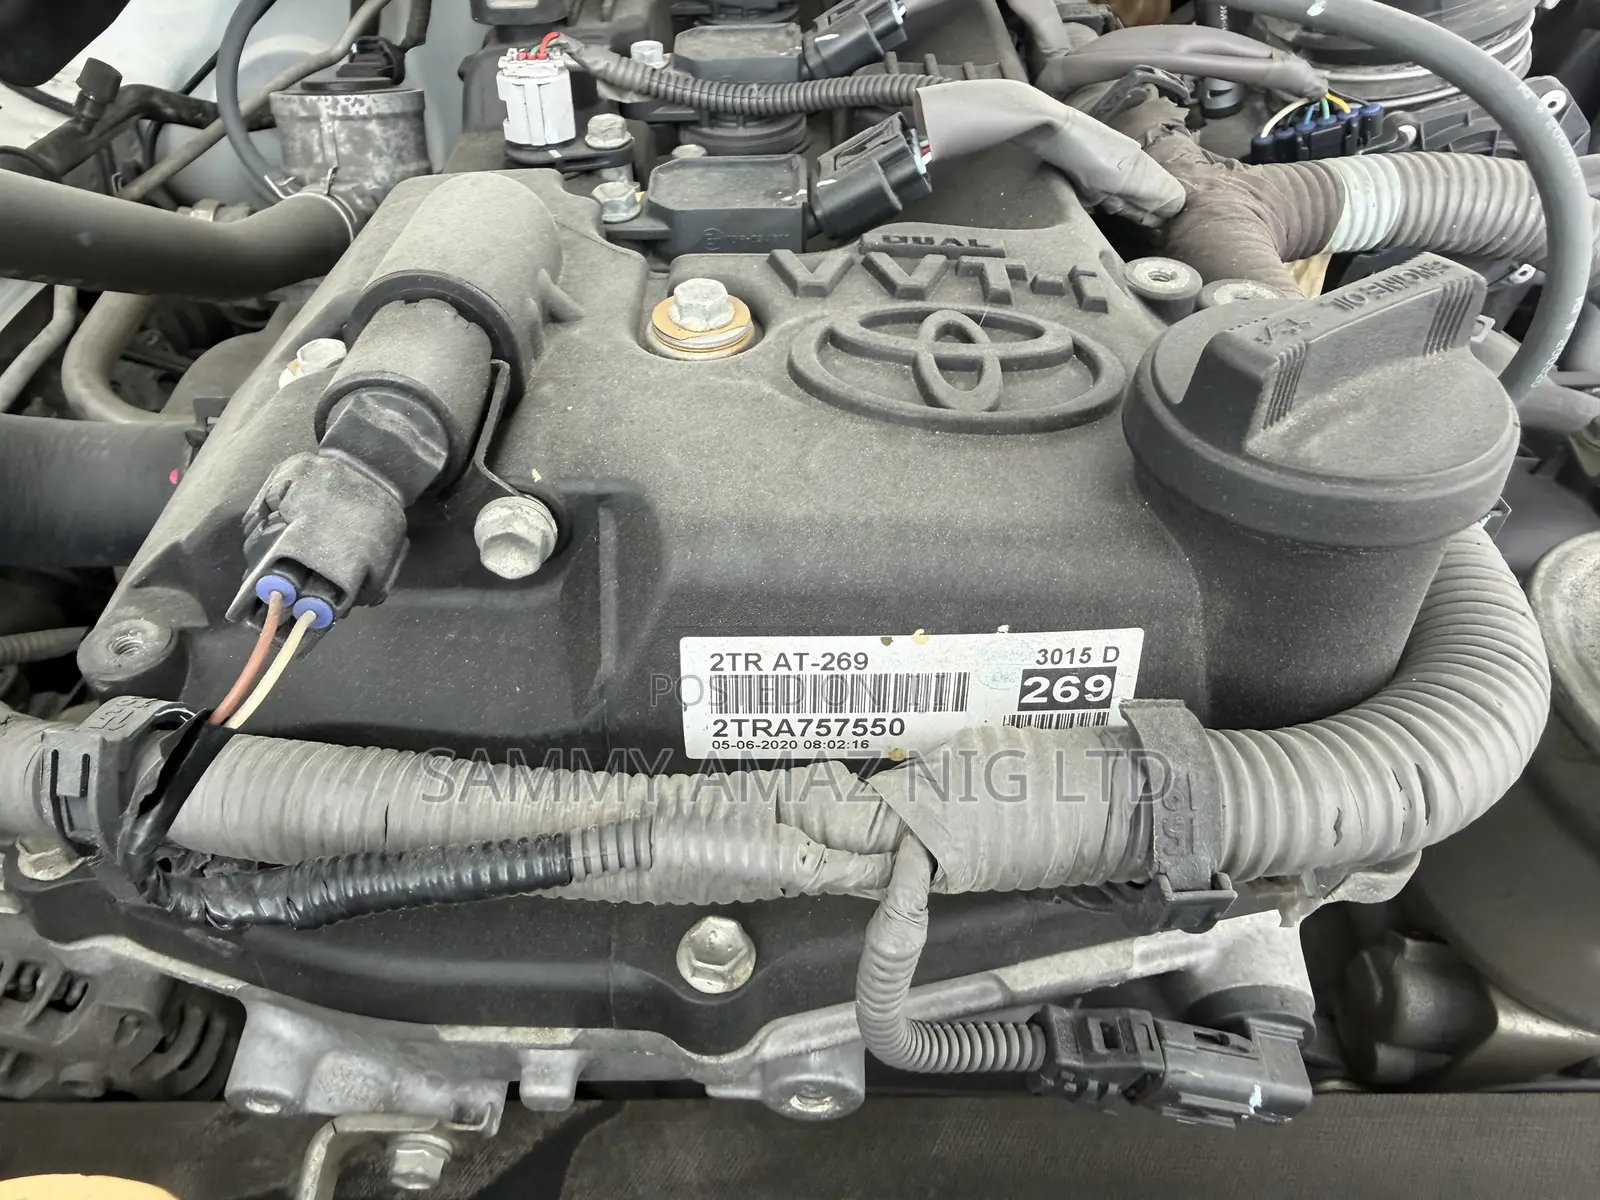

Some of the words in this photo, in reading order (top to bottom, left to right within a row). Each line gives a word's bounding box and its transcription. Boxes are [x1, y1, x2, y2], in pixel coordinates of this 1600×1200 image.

[880, 234, 991, 248] DUAL
[709, 652, 763, 672] 2TR
[772, 651, 869, 671] AT-269
[1035, 647, 1092, 666] 3015
[1102, 646, 1120, 664] D
[1020, 674, 1113, 704] 269
[712, 717, 906, 738] 2TRA757550
[711, 740, 798, 750] 05-06-2020
[803, 739, 869, 750] 08:02:16
